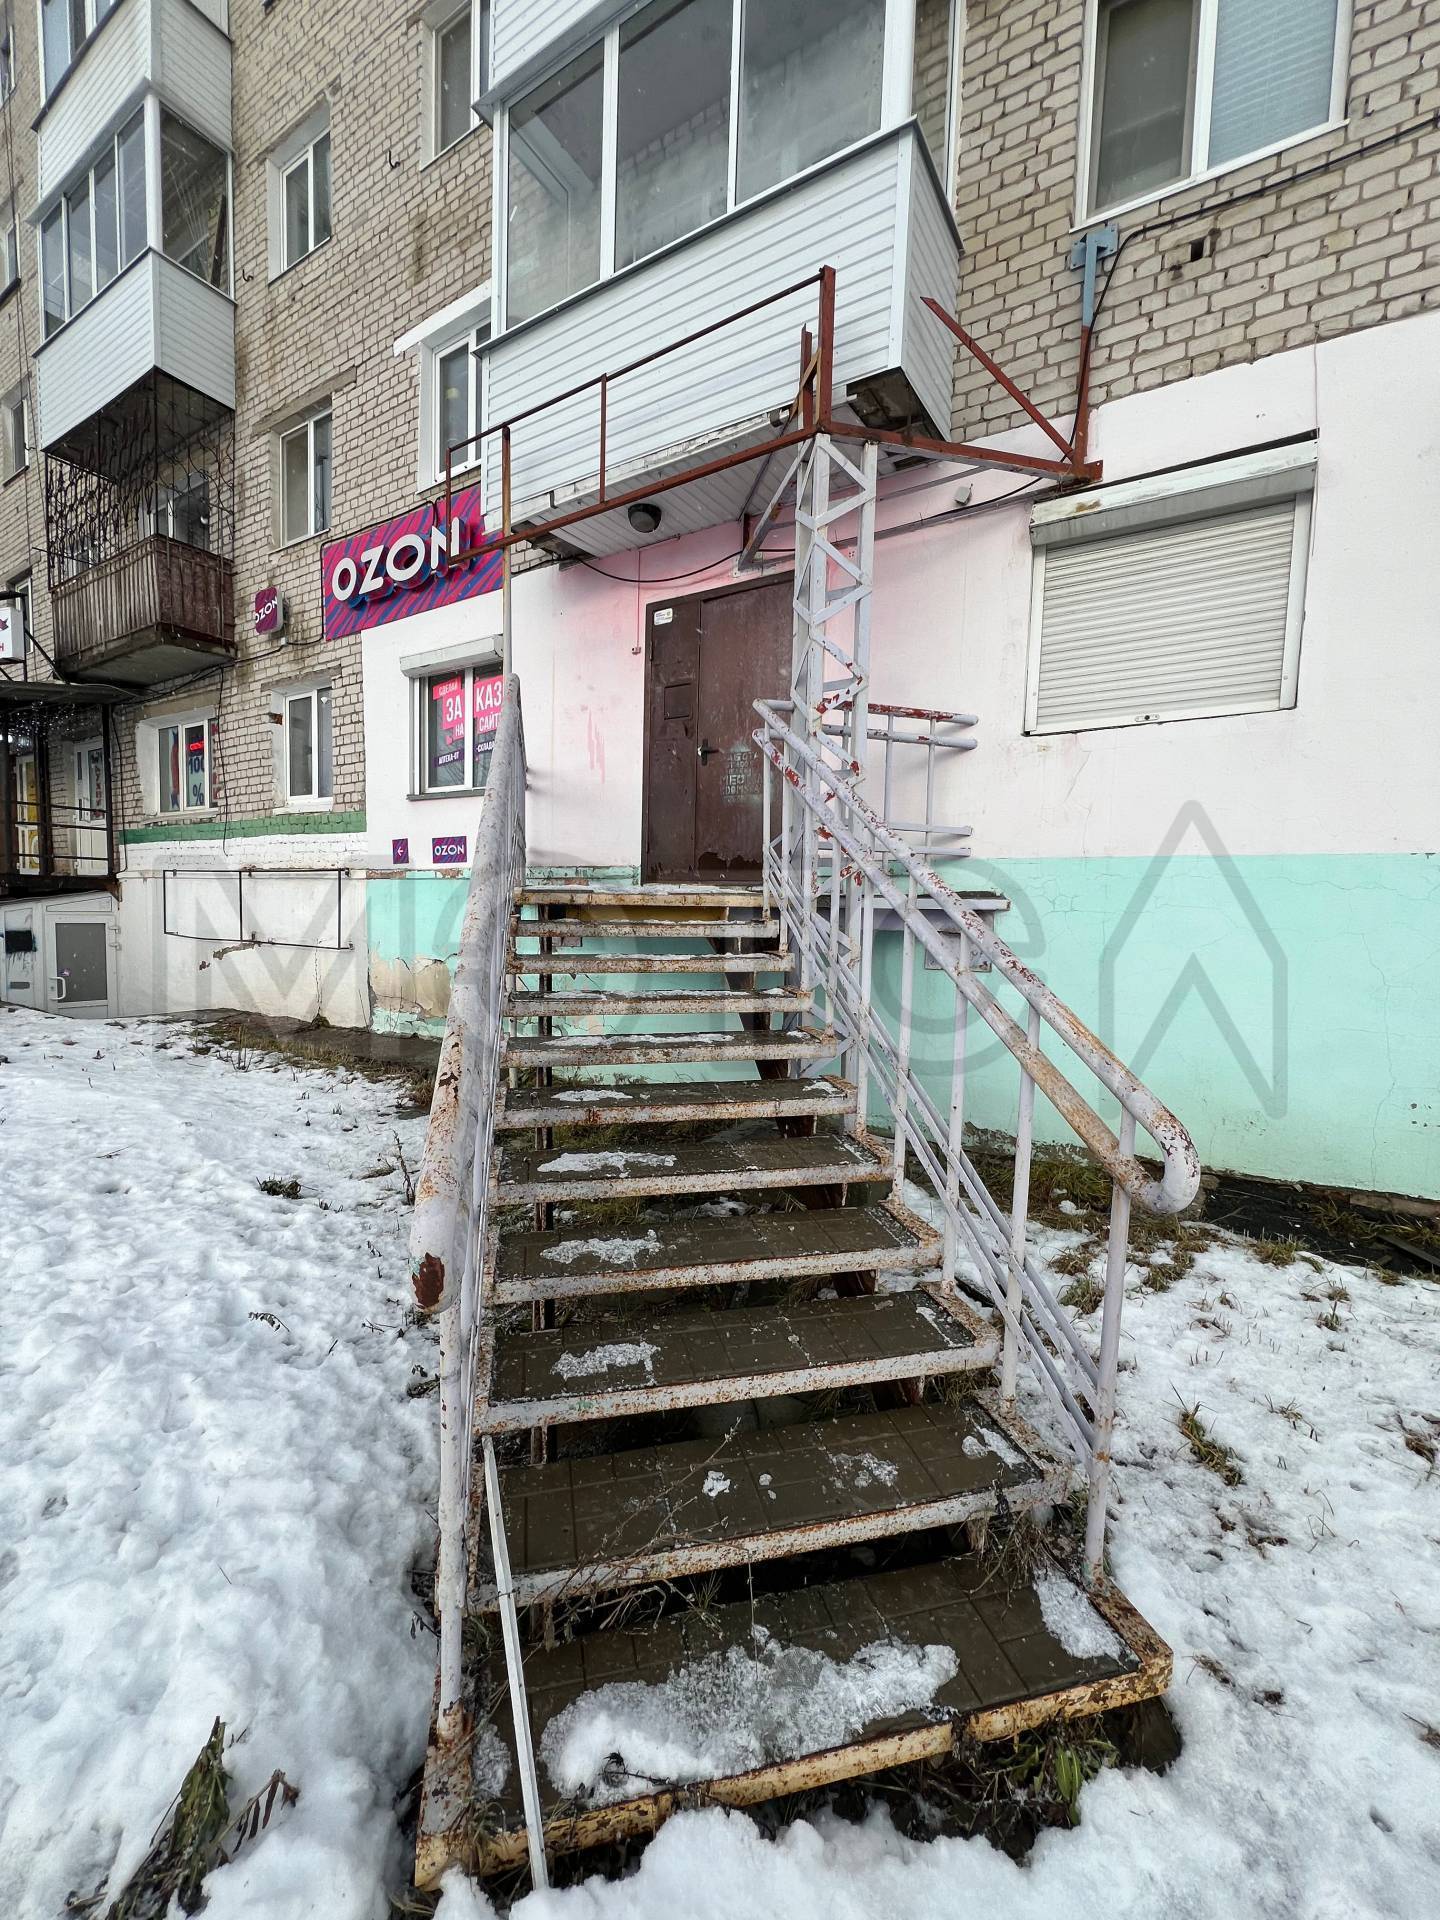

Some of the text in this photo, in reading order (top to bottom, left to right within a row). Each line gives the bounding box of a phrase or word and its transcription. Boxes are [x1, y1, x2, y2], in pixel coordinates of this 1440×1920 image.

[331, 516, 460, 601] OZON
[456, 711, 500, 737] НА САЙТ
[434, 844, 465, 856] OZON
